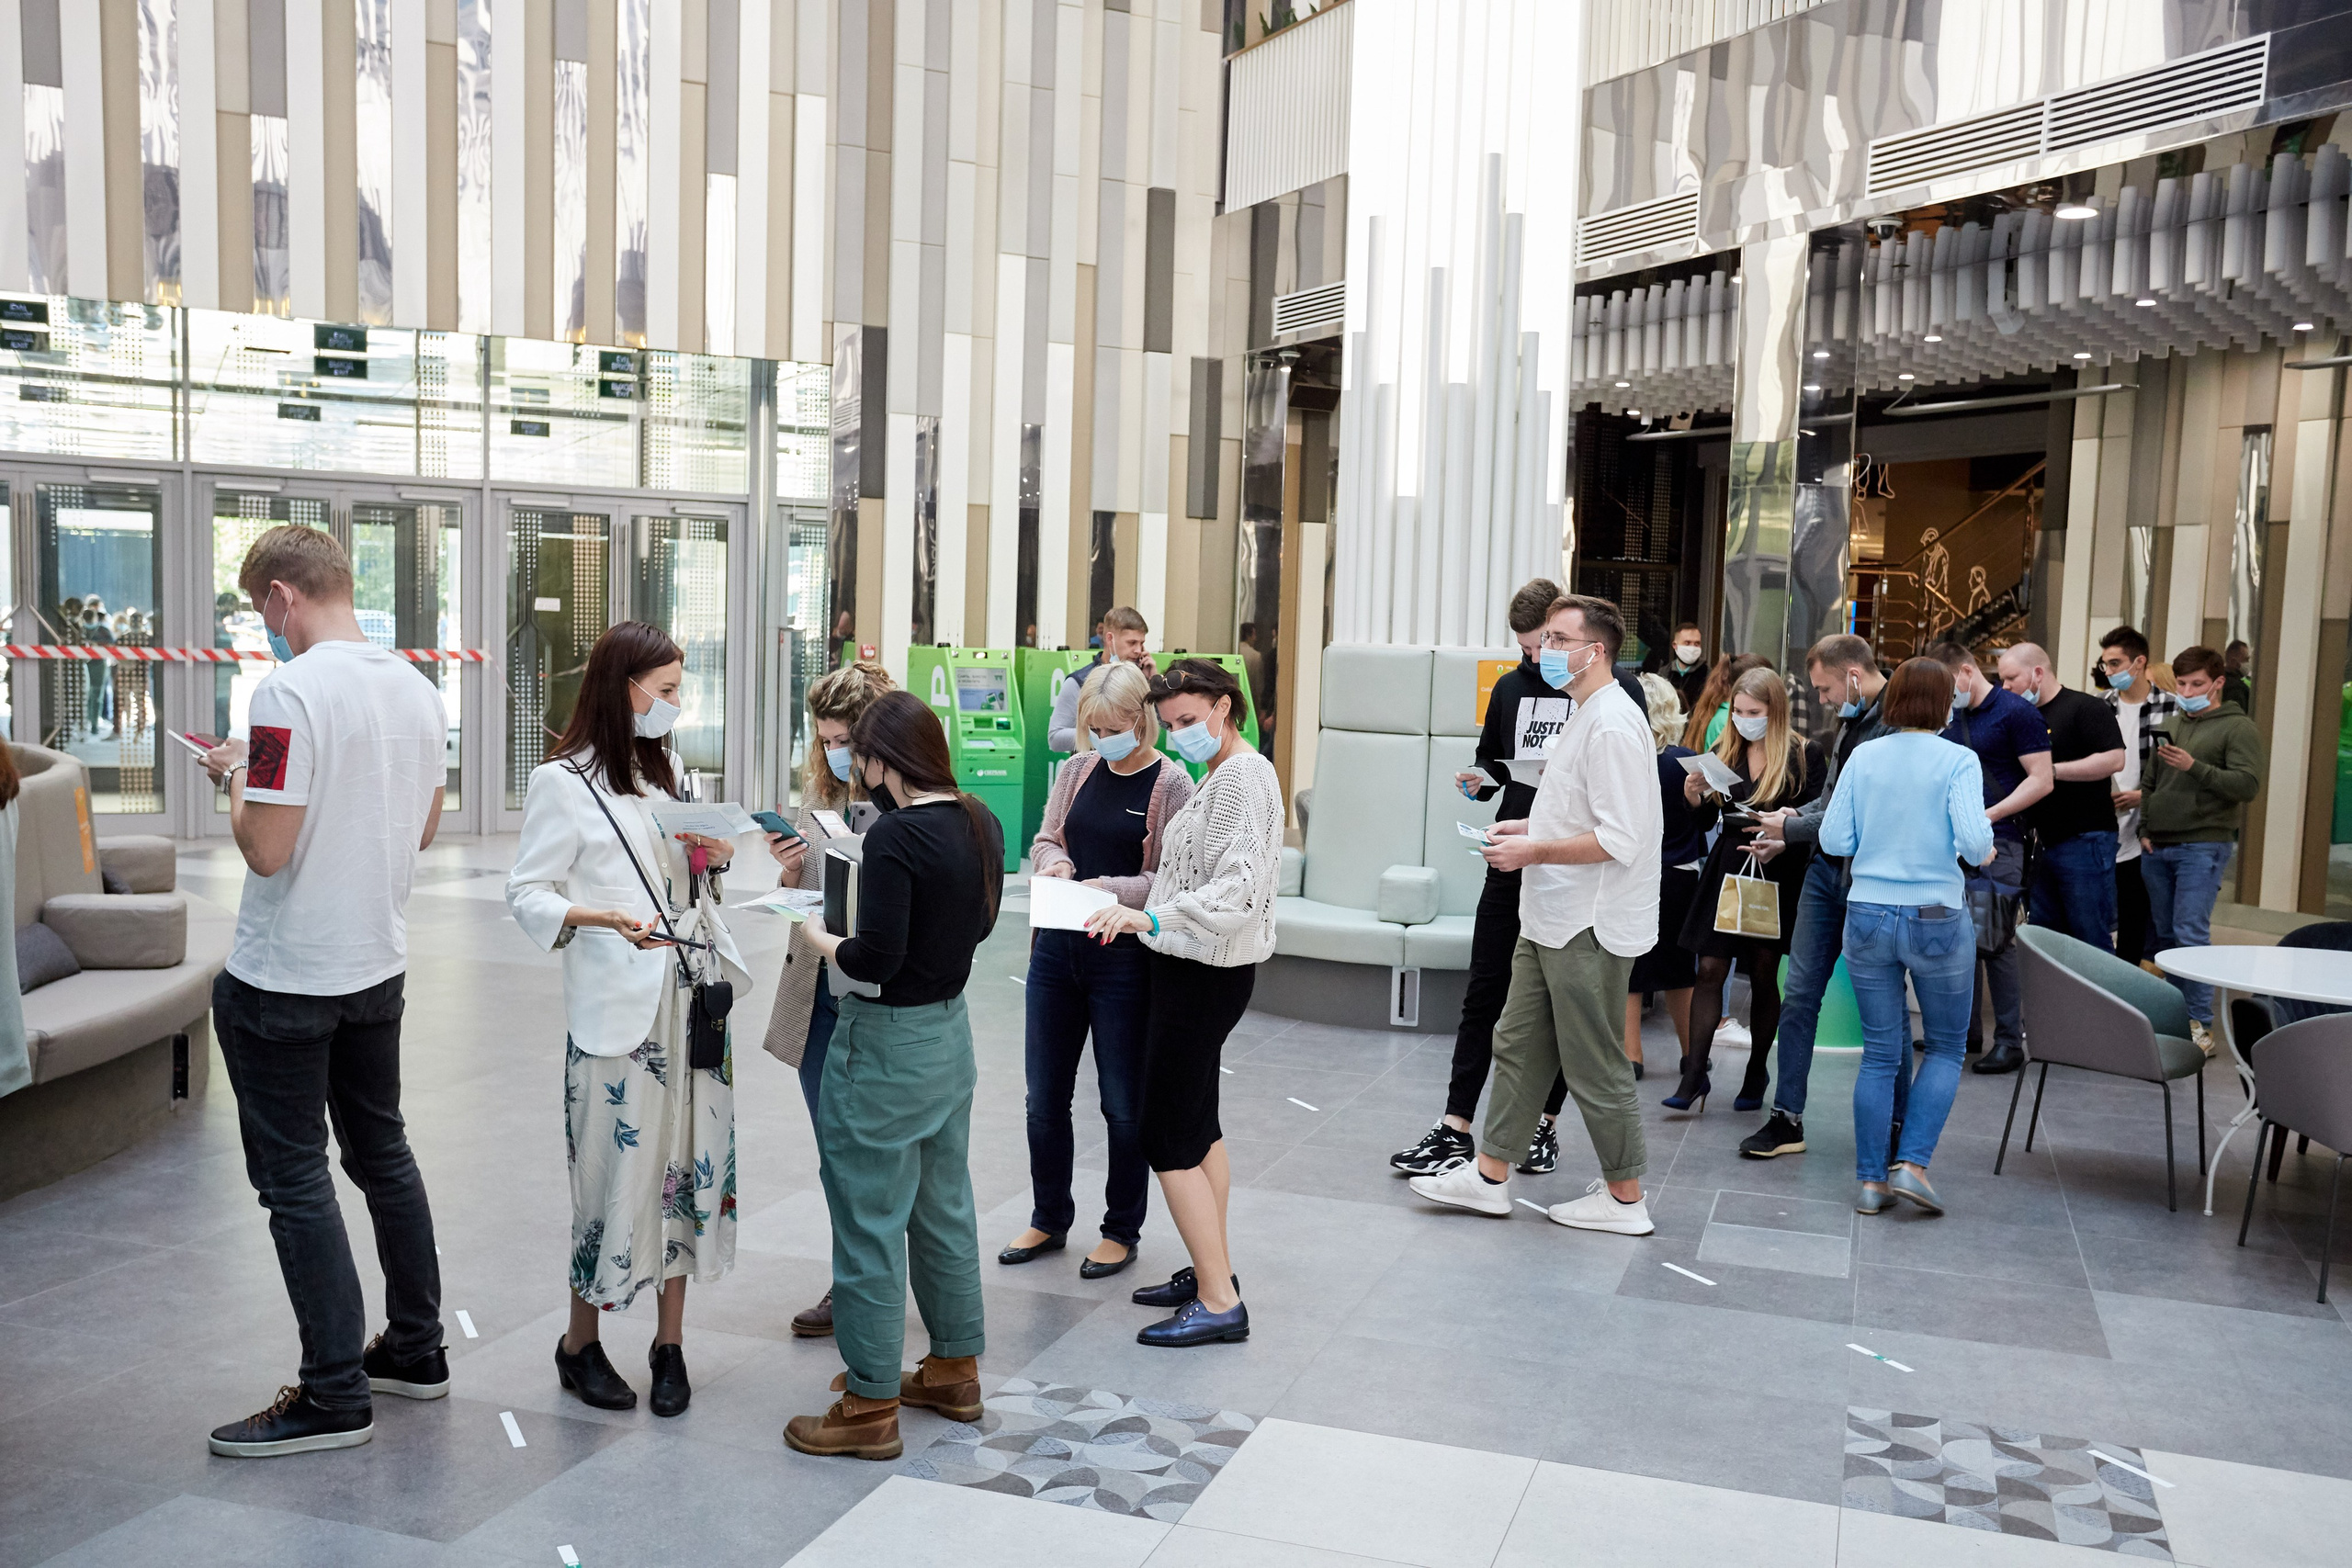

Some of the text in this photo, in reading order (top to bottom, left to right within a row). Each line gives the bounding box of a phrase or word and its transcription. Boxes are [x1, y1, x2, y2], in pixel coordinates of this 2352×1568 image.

[1526, 721, 1565, 735] JUST D
[1521, 735, 1548, 749] NOT
